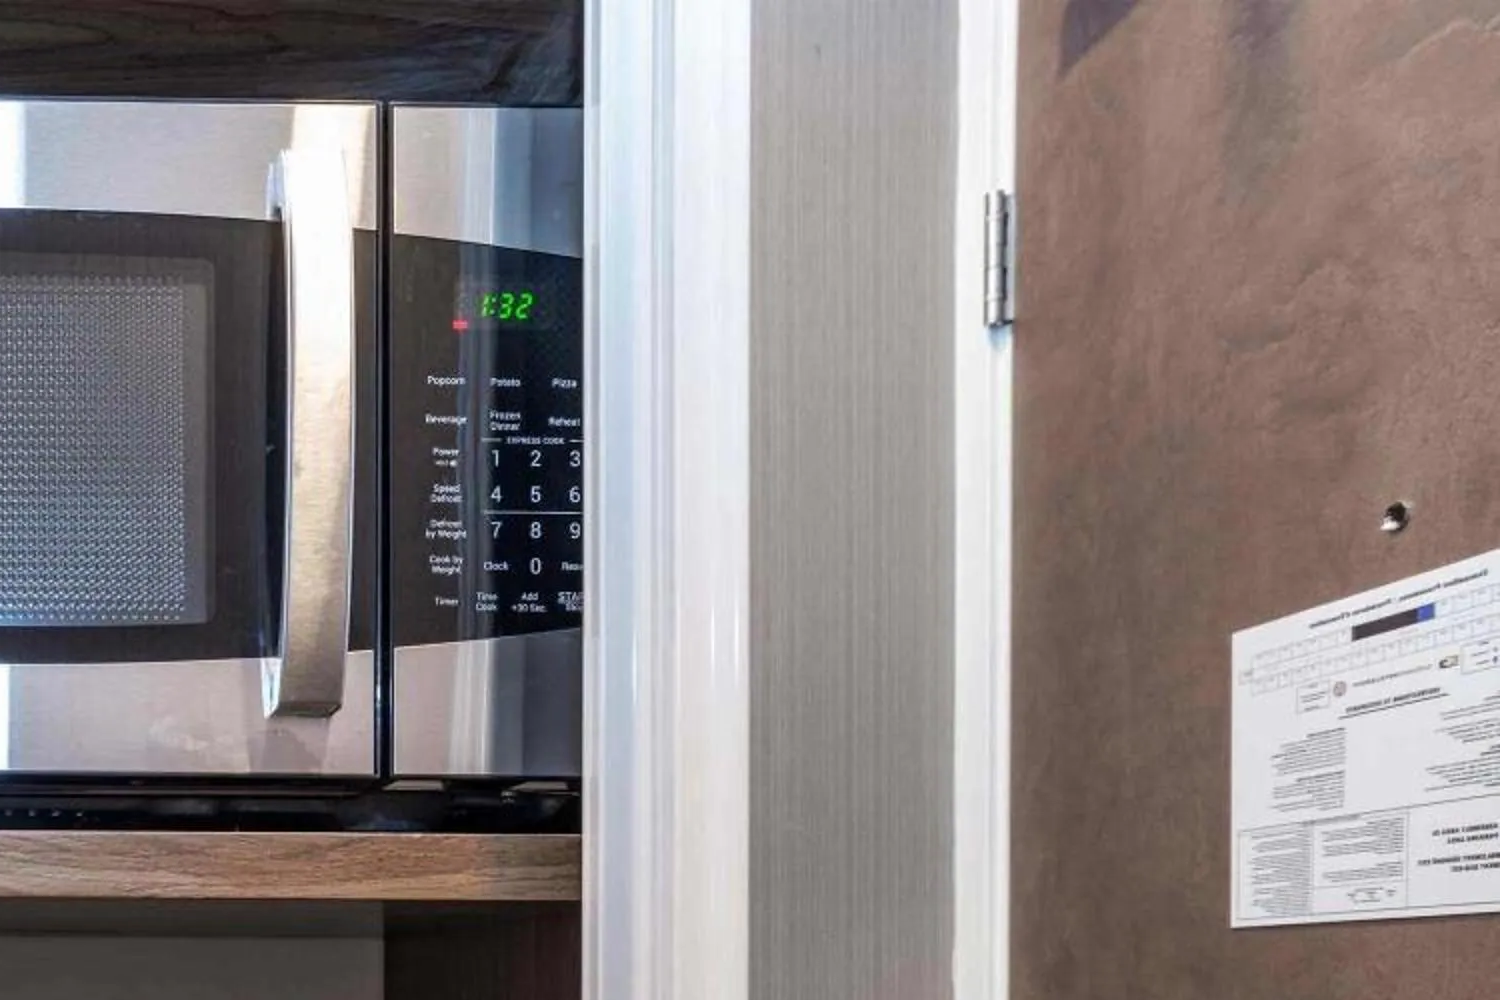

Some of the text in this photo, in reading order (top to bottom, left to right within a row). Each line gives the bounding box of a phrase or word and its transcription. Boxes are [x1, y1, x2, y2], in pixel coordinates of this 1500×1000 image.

[481, 292, 533, 319] 1:32
[427, 375, 466, 387] Popcorn
[551, 377, 577, 388] Pizza
[491, 450, 500, 467] 1
[530, 450, 541, 467] 2
[569, 451, 581, 467] 3
[490, 486, 502, 503] 4
[530, 486, 541, 503] 5
[569, 486, 581, 503] 6
[491, 522, 502, 539] 7
[529, 522, 542, 539] 8
[569, 522, 581, 539] 9
[483, 561, 508, 571] Clock
[529, 558, 541, 575] 0
